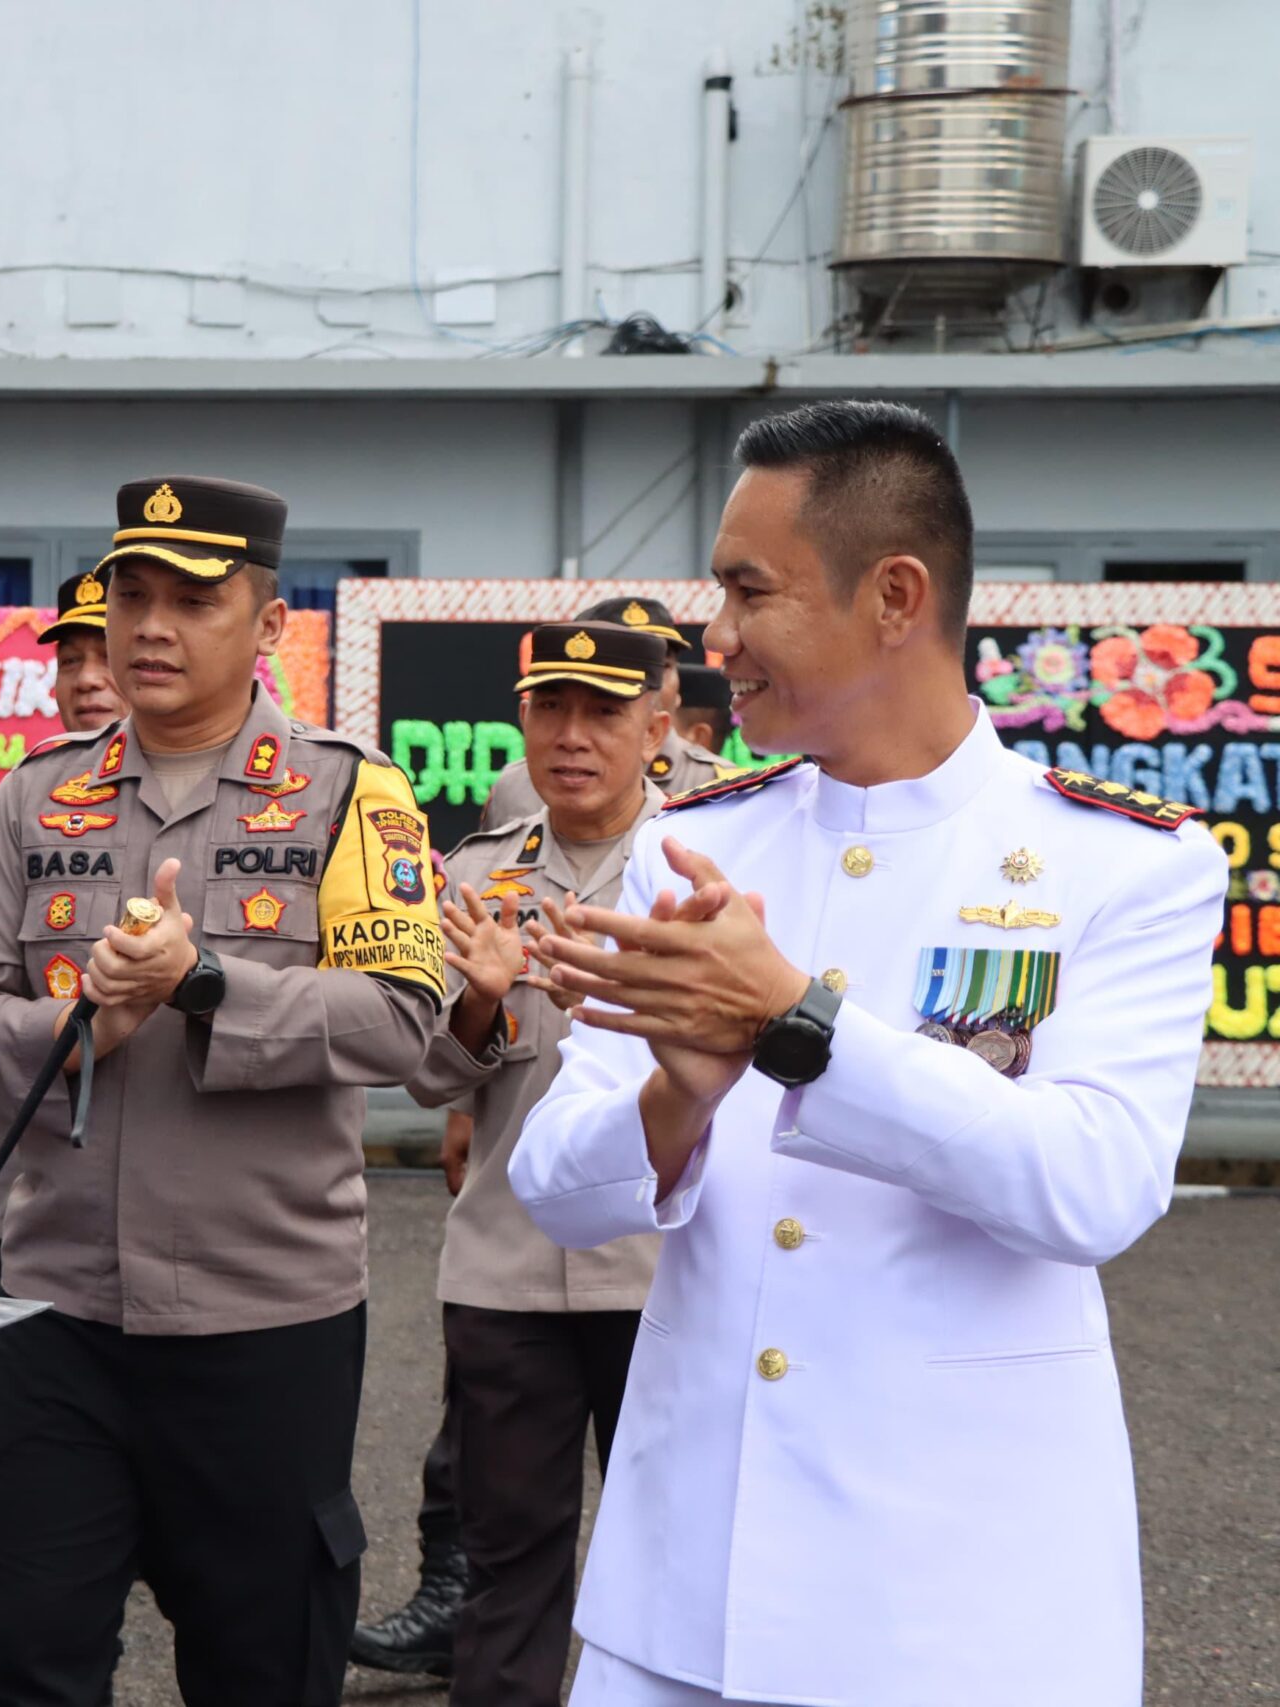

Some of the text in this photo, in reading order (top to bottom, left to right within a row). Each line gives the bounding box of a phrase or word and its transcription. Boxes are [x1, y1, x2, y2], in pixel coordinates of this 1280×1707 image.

[378, 811, 418, 829] POLRES
[27, 851, 114, 879] BASA
[215, 847, 317, 877] POLRI
